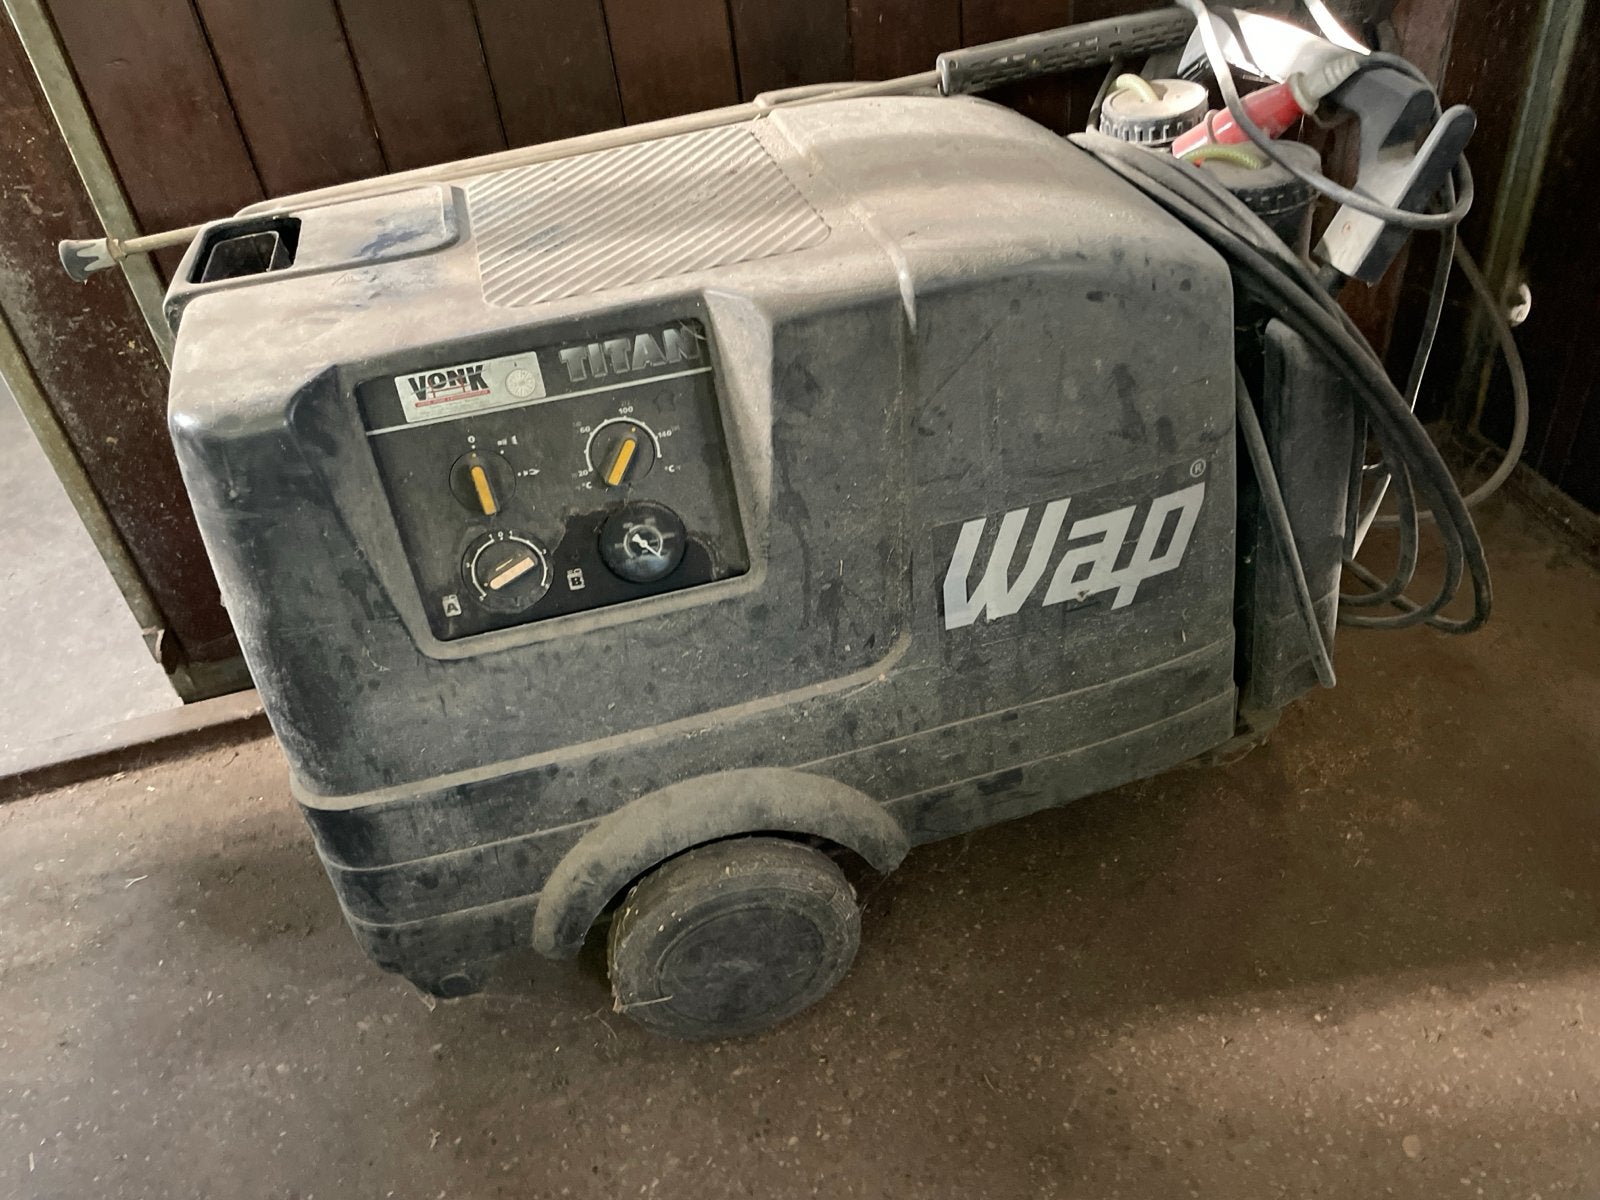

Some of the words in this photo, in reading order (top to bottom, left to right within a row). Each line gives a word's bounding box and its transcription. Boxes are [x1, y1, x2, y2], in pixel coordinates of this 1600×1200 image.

[559, 329, 698, 382] TITAN
[408, 365, 489, 401] VONK
[618, 406, 634, 415] 100
[580, 425, 591, 434] 60
[658, 430, 672, 439] 140
[578, 469, 589, 478] 20
[447, 603, 459, 613] A
